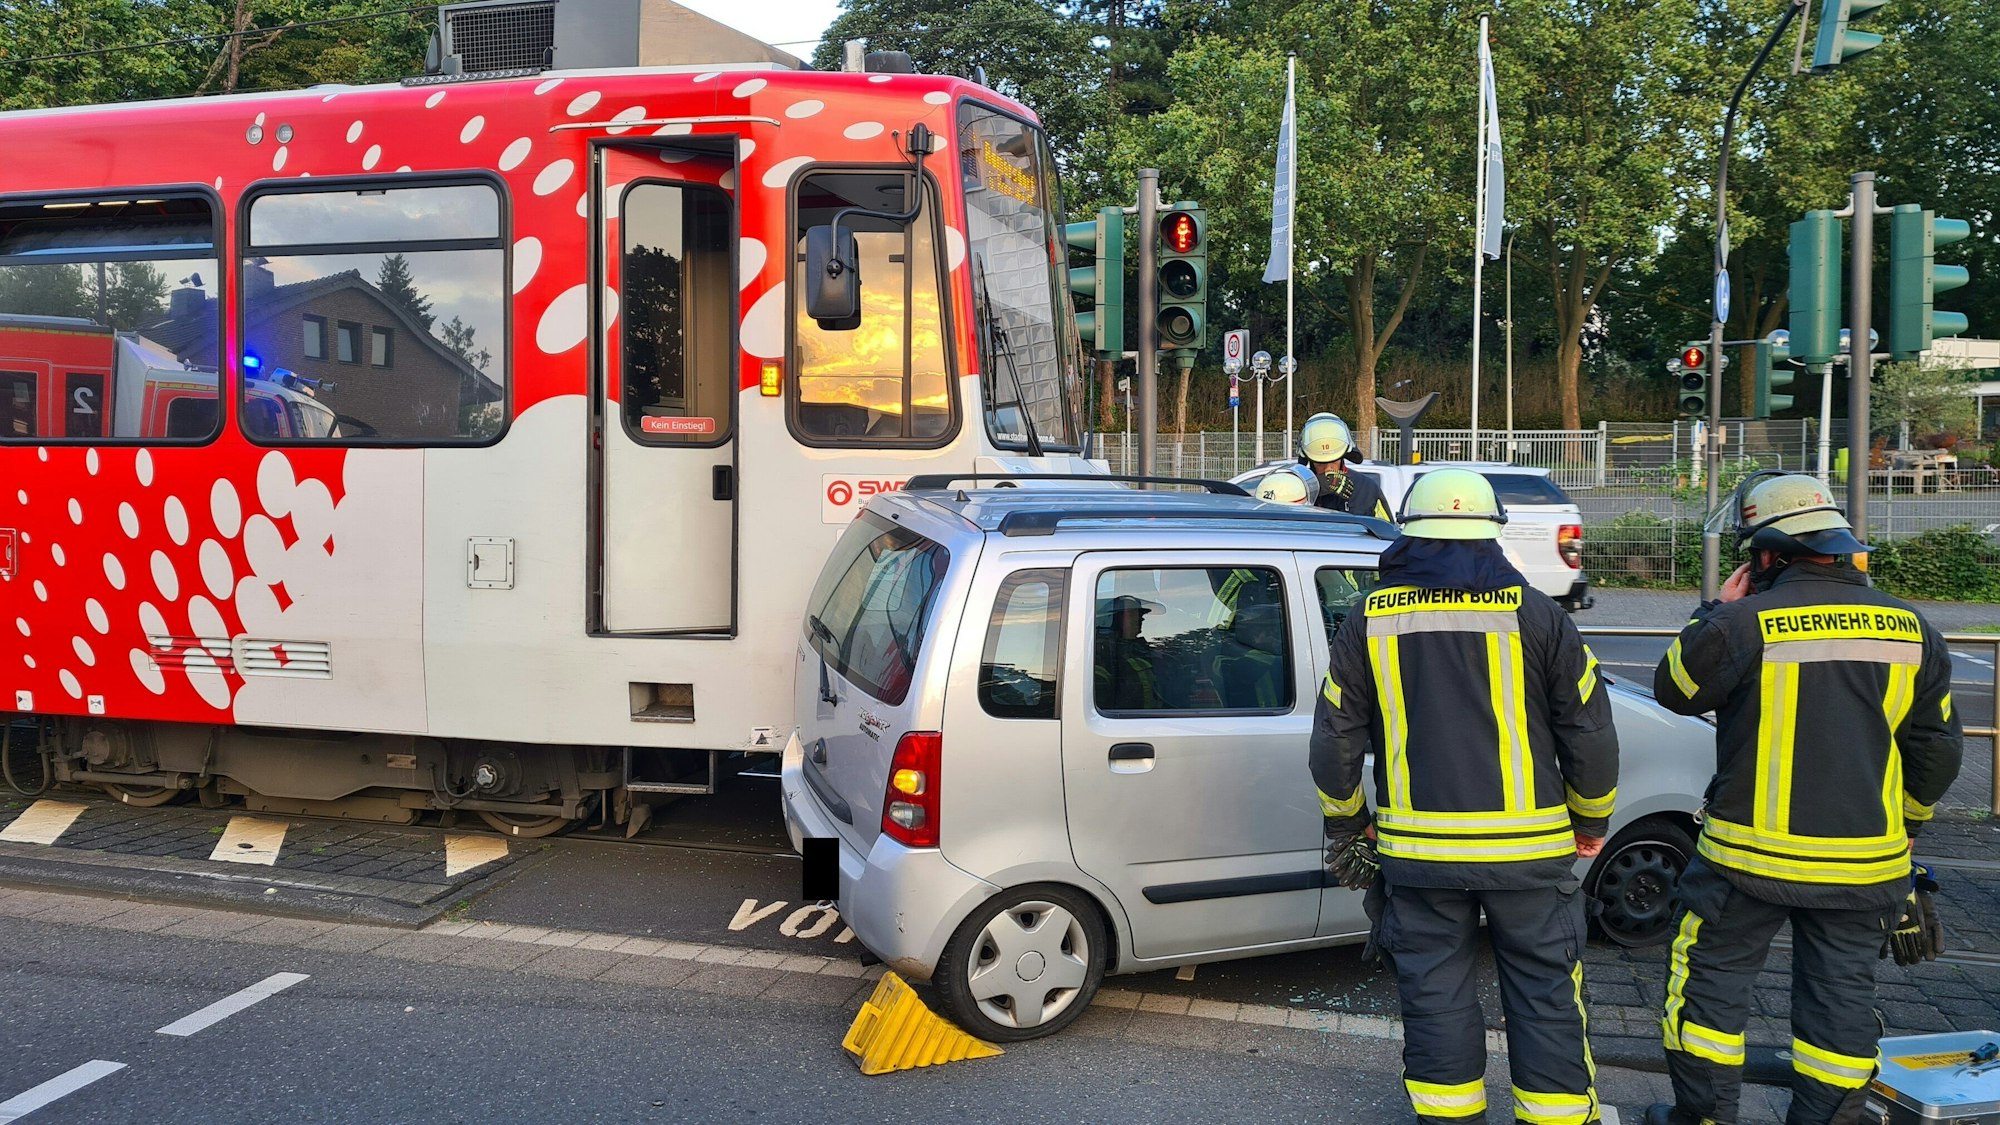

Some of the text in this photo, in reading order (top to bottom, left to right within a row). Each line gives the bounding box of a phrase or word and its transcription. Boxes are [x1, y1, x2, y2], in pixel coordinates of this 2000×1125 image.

[1230, 340, 1238, 352] 30
[651, 421, 706, 431] Kein Einstieg!
[1453, 498, 1460, 510] 2
[1815, 492, 1824, 504] 2
[1369, 588, 1517, 611] FEUERWEHR BONN
[1765, 613, 1919, 635] FEUERWEHR BONN
